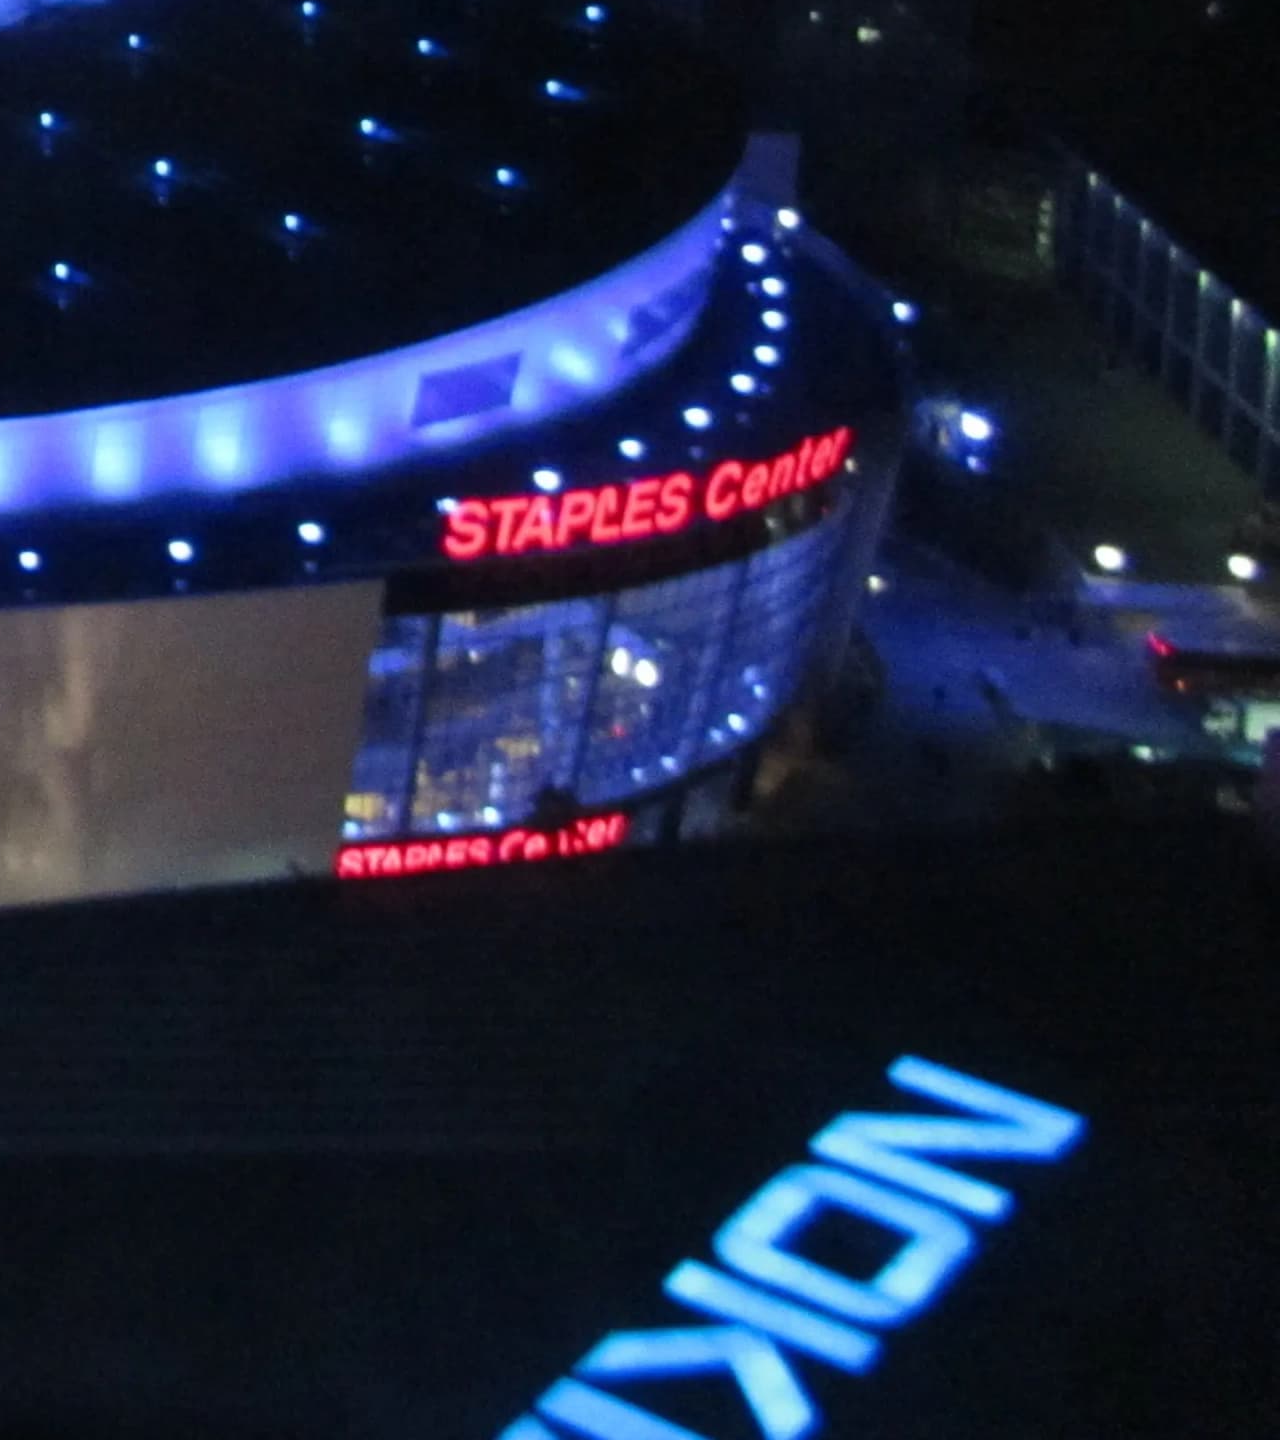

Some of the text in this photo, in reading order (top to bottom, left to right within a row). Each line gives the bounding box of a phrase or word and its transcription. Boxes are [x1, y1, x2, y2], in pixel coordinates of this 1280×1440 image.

[443, 427, 850, 560] STAPLES Center
[492, 1054, 1088, 1440] NOKI
